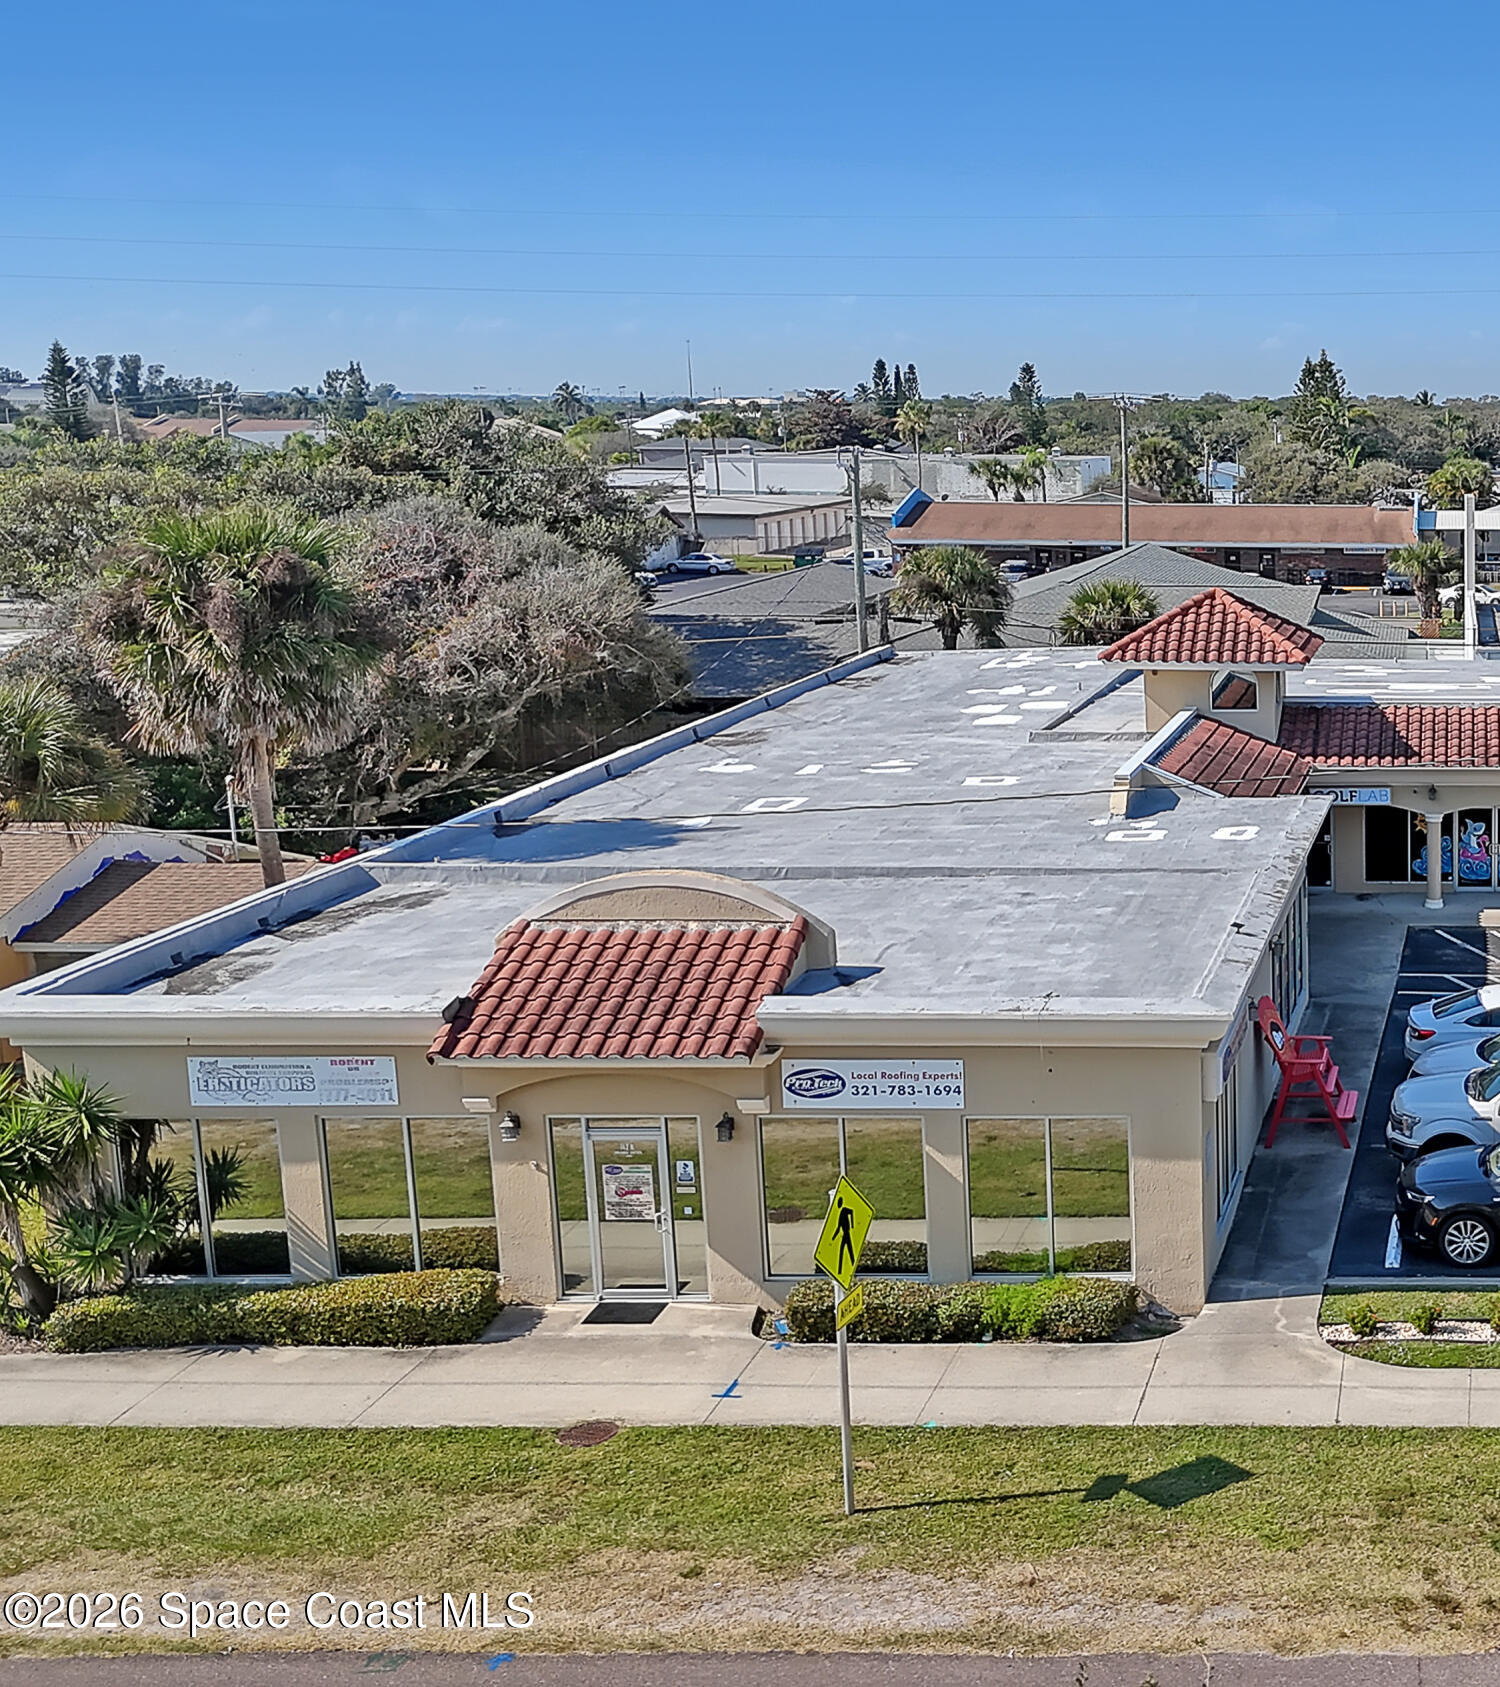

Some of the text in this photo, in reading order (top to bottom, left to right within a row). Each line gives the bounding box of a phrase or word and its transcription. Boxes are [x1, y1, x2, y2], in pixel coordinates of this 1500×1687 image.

[851, 1071, 962, 1081] Local Roofing Experts!
[851, 1085, 962, 1096] 321-783-1694
